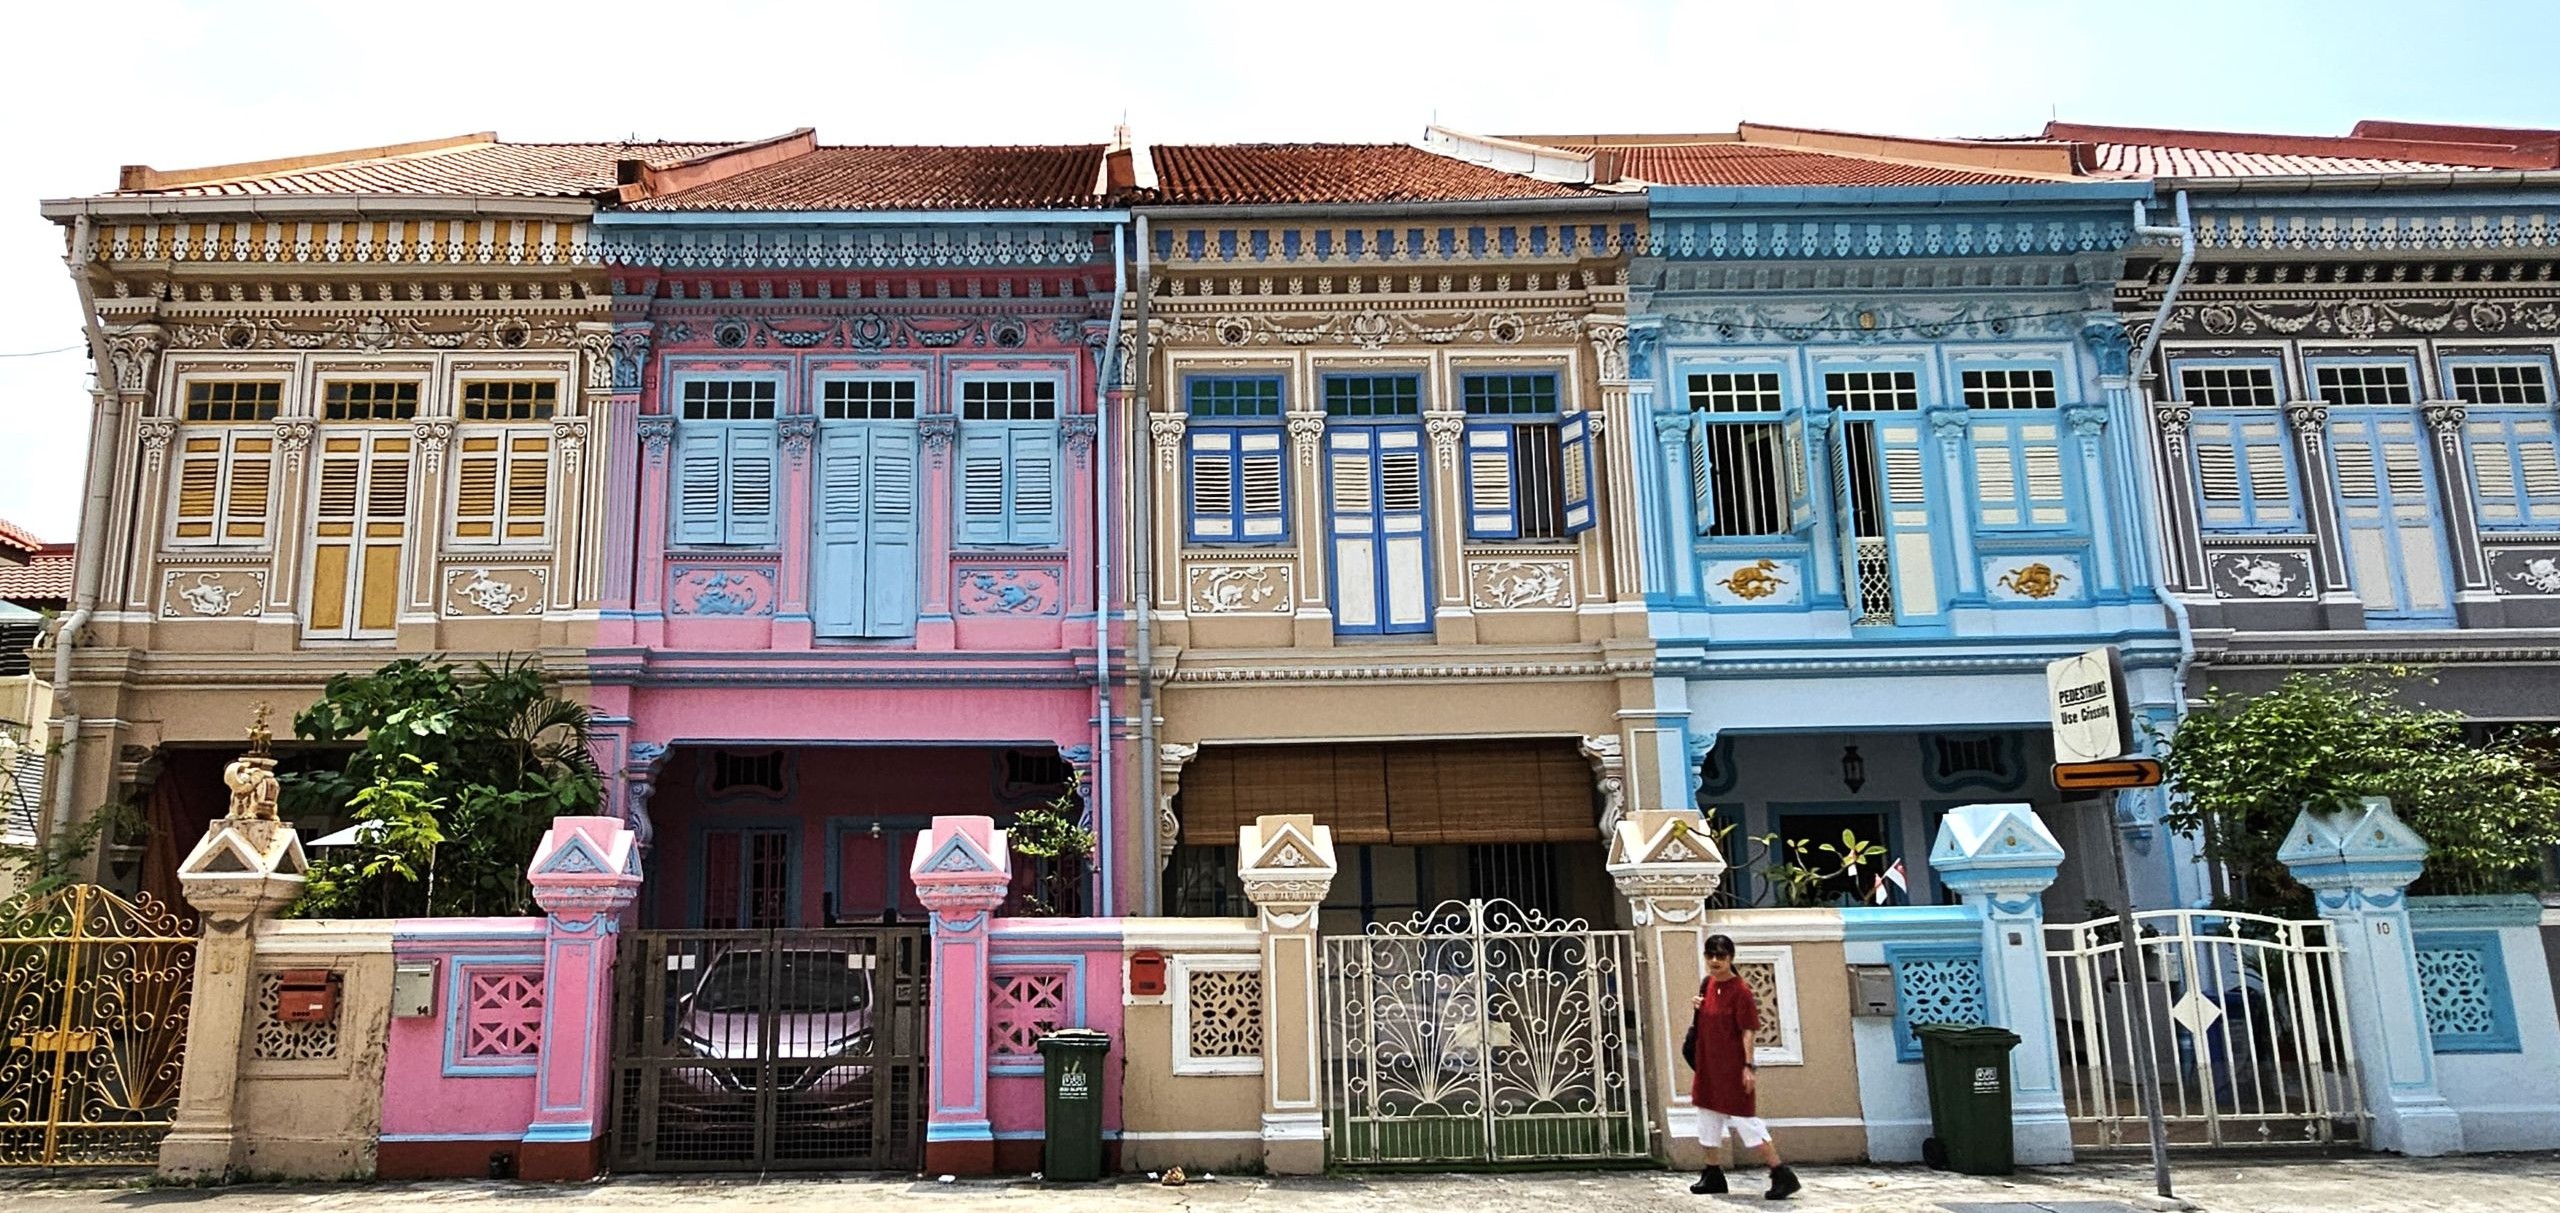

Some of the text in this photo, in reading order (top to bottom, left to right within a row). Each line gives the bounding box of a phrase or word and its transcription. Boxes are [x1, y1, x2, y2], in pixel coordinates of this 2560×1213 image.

[2059, 680, 2106, 704] PEDESTRIANS
[2061, 705, 2110, 725] Use Crossing
[2376, 922, 2390, 935] 10
[417, 1005, 429, 1016] 14
